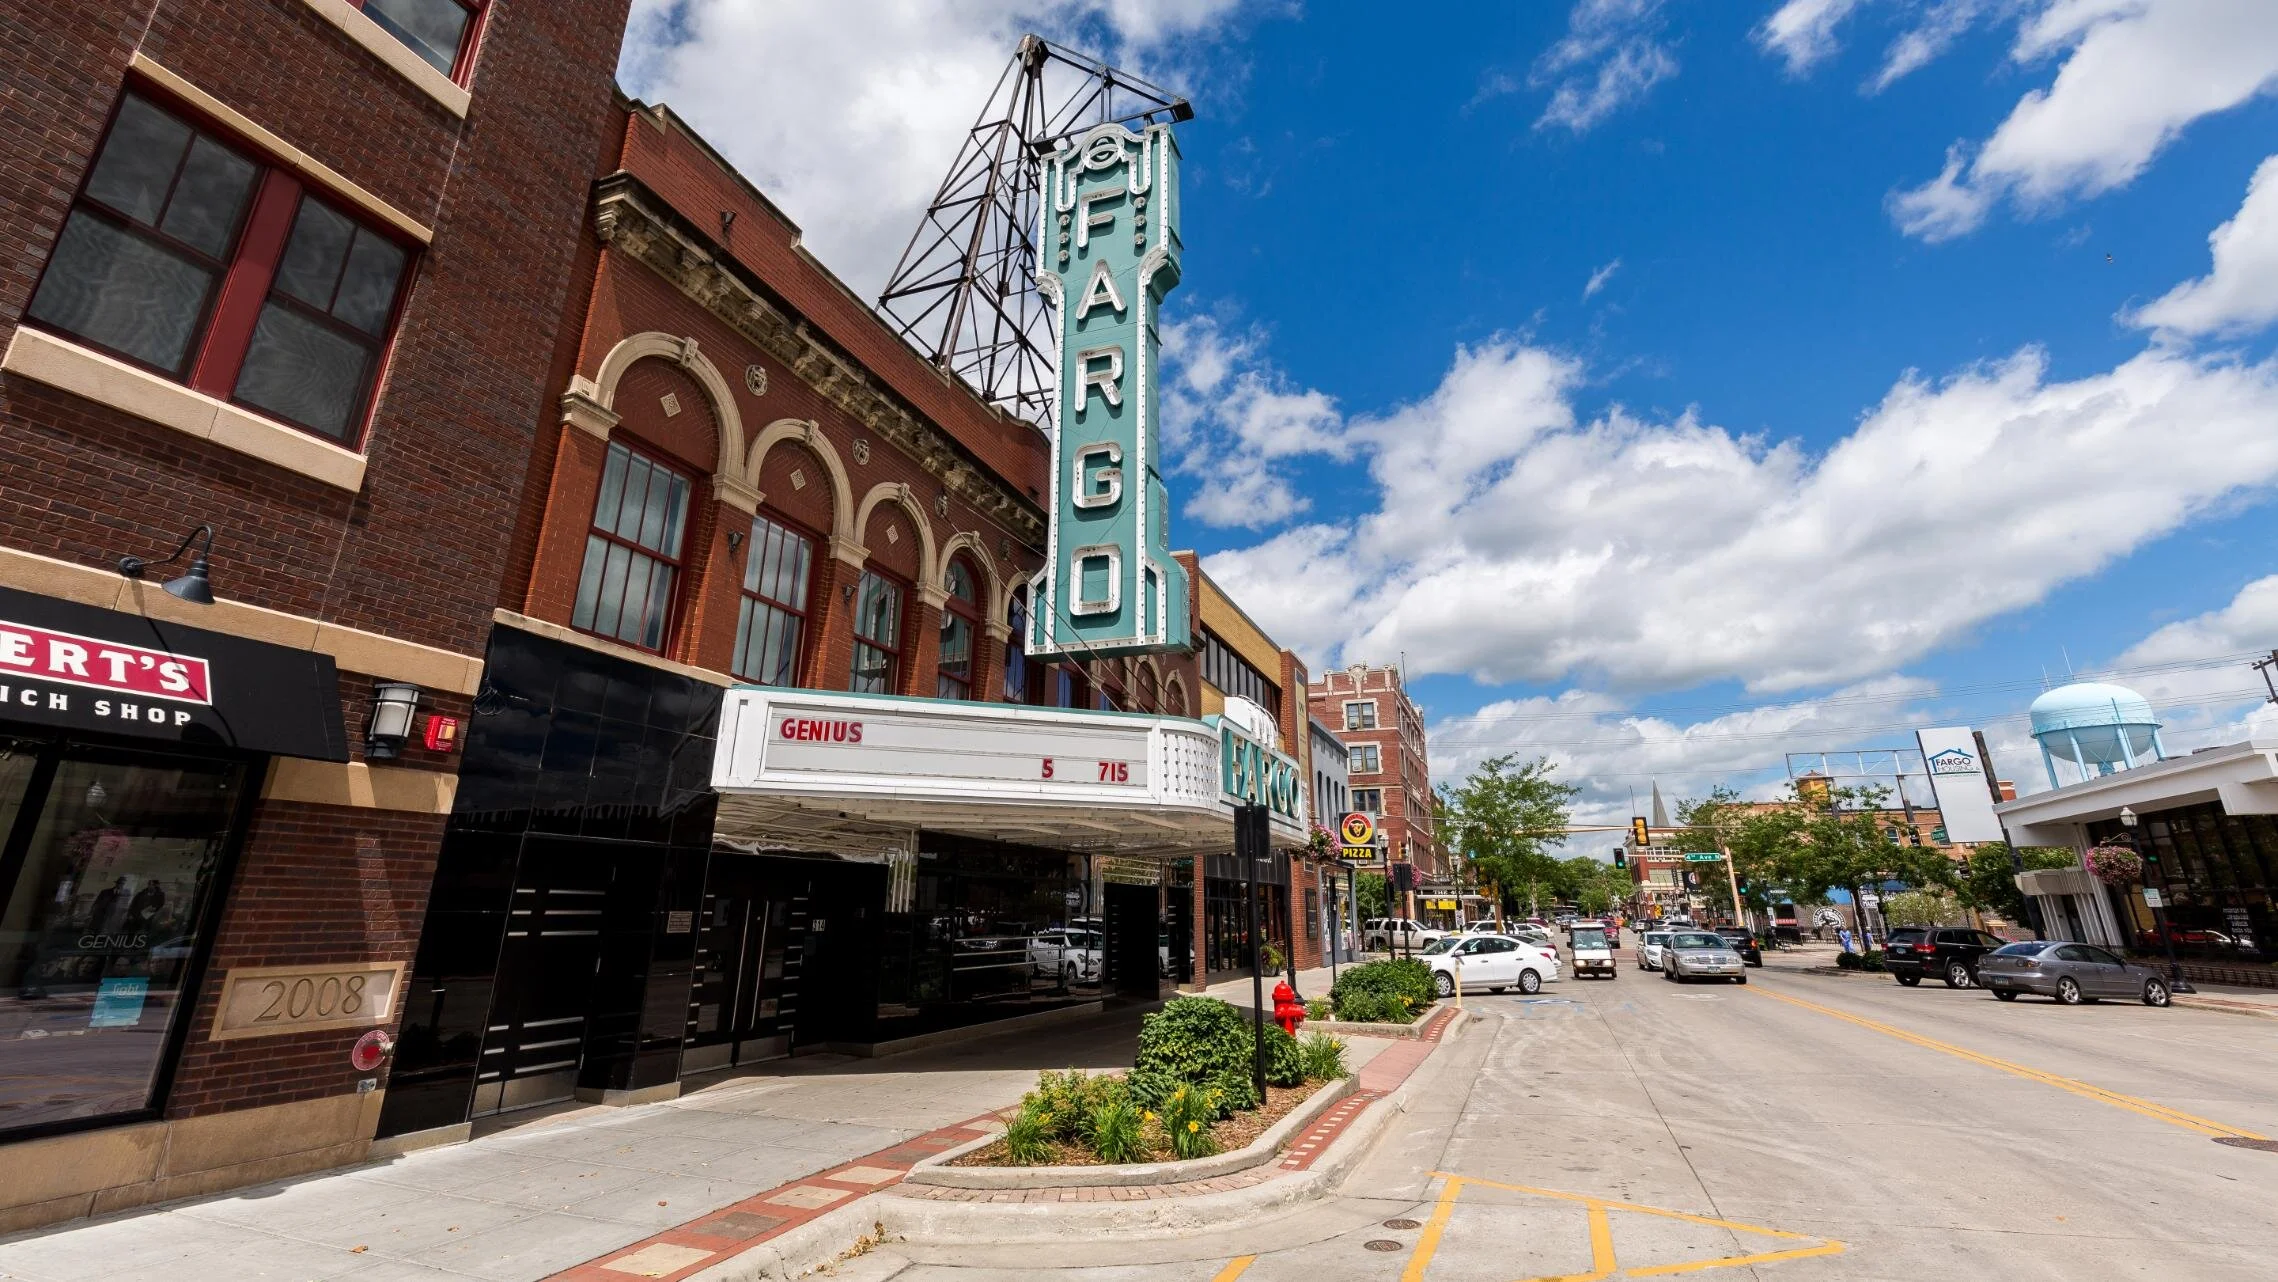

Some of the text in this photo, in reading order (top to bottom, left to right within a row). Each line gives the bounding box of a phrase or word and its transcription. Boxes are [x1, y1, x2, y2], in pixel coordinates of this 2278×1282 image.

[1069, 187, 1127, 616] FARGO
[94, 700, 192, 726] SHOP
[780, 718, 863, 743] GENIUS
[1042, 758, 1129, 782] 5 715
[1223, 728, 1301, 818] FARGO
[1935, 757, 1971, 766] FARGO
[1343, 848, 1372, 858] PIZZA
[78, 934, 147, 949] GENIUS
[253, 975, 365, 1022] 2008
